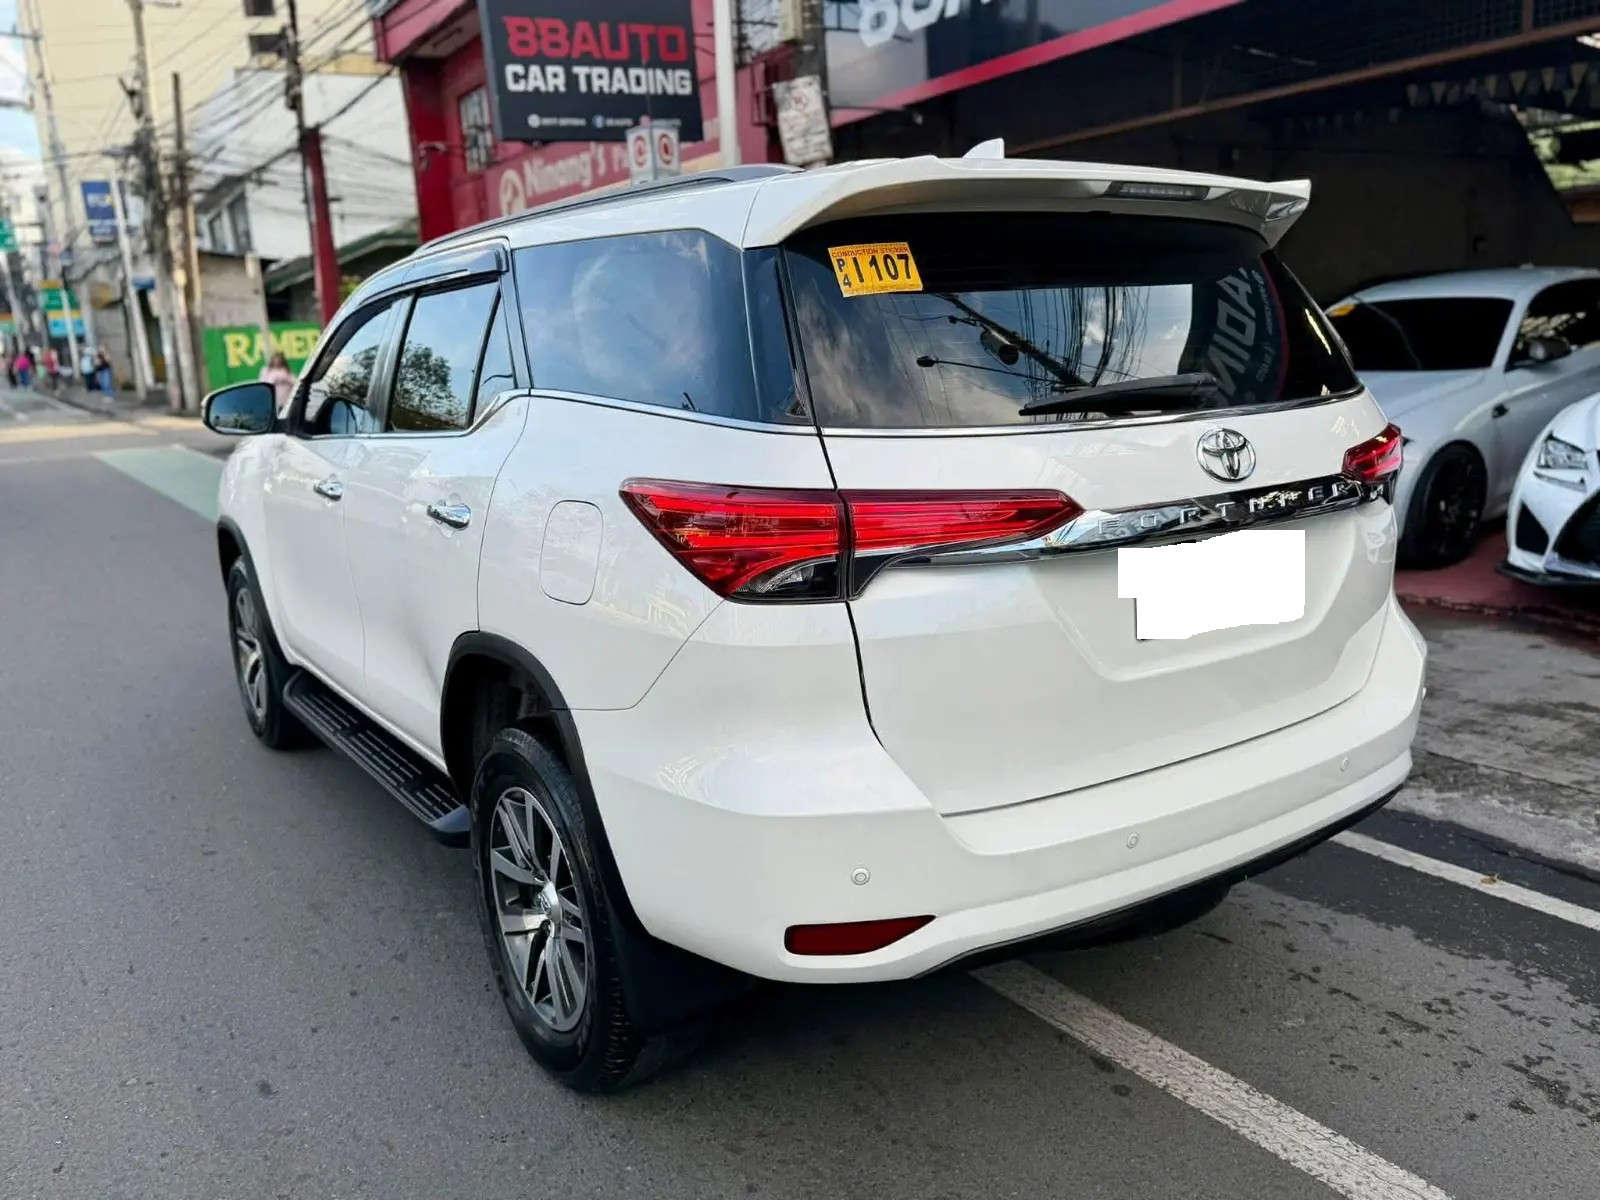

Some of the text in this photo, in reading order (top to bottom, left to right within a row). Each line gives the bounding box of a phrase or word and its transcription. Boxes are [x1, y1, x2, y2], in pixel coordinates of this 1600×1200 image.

[503, 16, 688, 62] 88AUTO
[505, 64, 692, 95] CAR TRADING
[832, 248, 879, 258] CONDUCTION
[836, 257, 846, 272] P
[843, 274, 852, 288] 4
